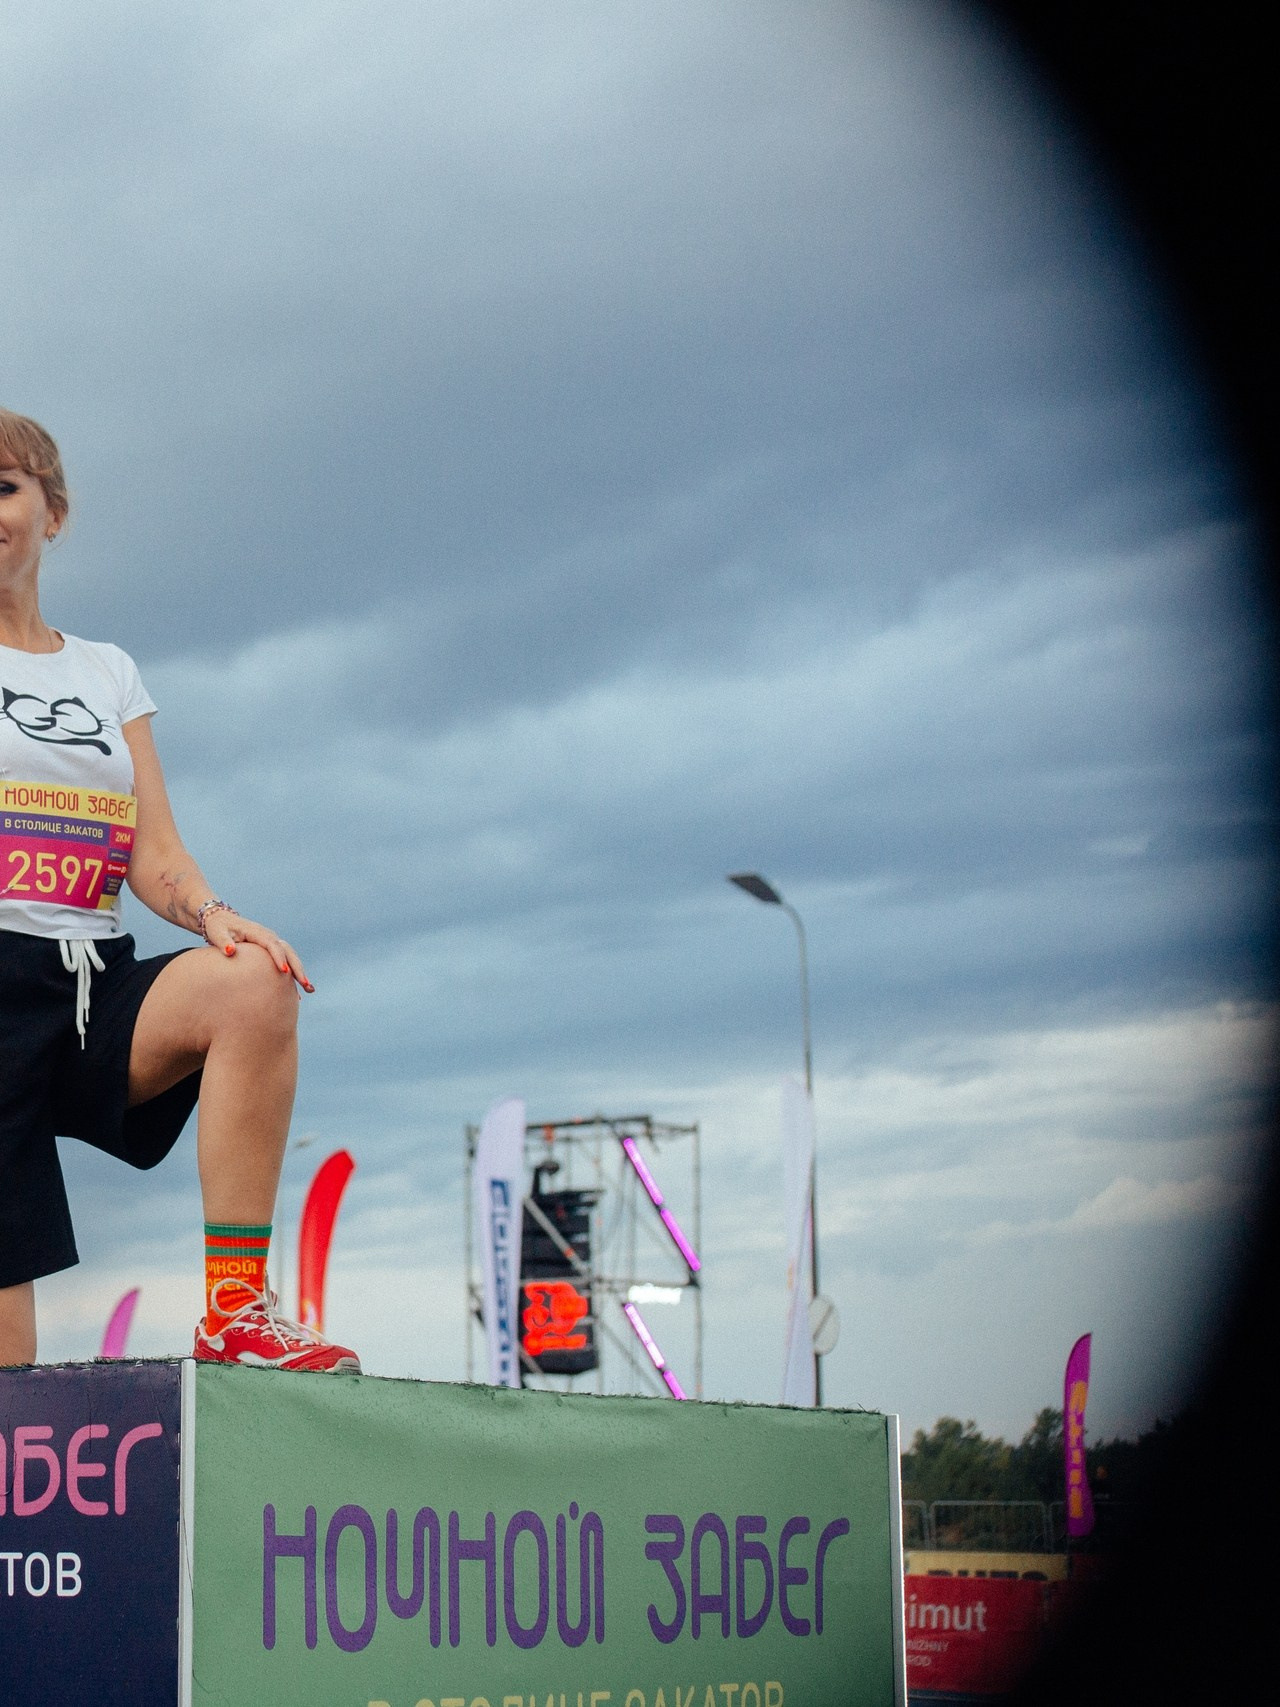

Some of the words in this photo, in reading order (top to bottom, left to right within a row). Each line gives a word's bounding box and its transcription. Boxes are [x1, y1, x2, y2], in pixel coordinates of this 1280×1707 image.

[4, 788, 80, 812] НОЧНОЙ
[88, 795, 135, 819] ЗАБЕГ
[4, 818, 12, 829] В
[14, 820, 62, 834] СТОЛИЦЕ
[64, 824, 104, 839] ЗАКАТОВ
[8, 850, 103, 899] 2597
[262, 1501, 605, 1653] НОЧНОЙ
[644, 1512, 850, 1644] ЗАБЕГ
[906, 1594, 987, 1633] imut
